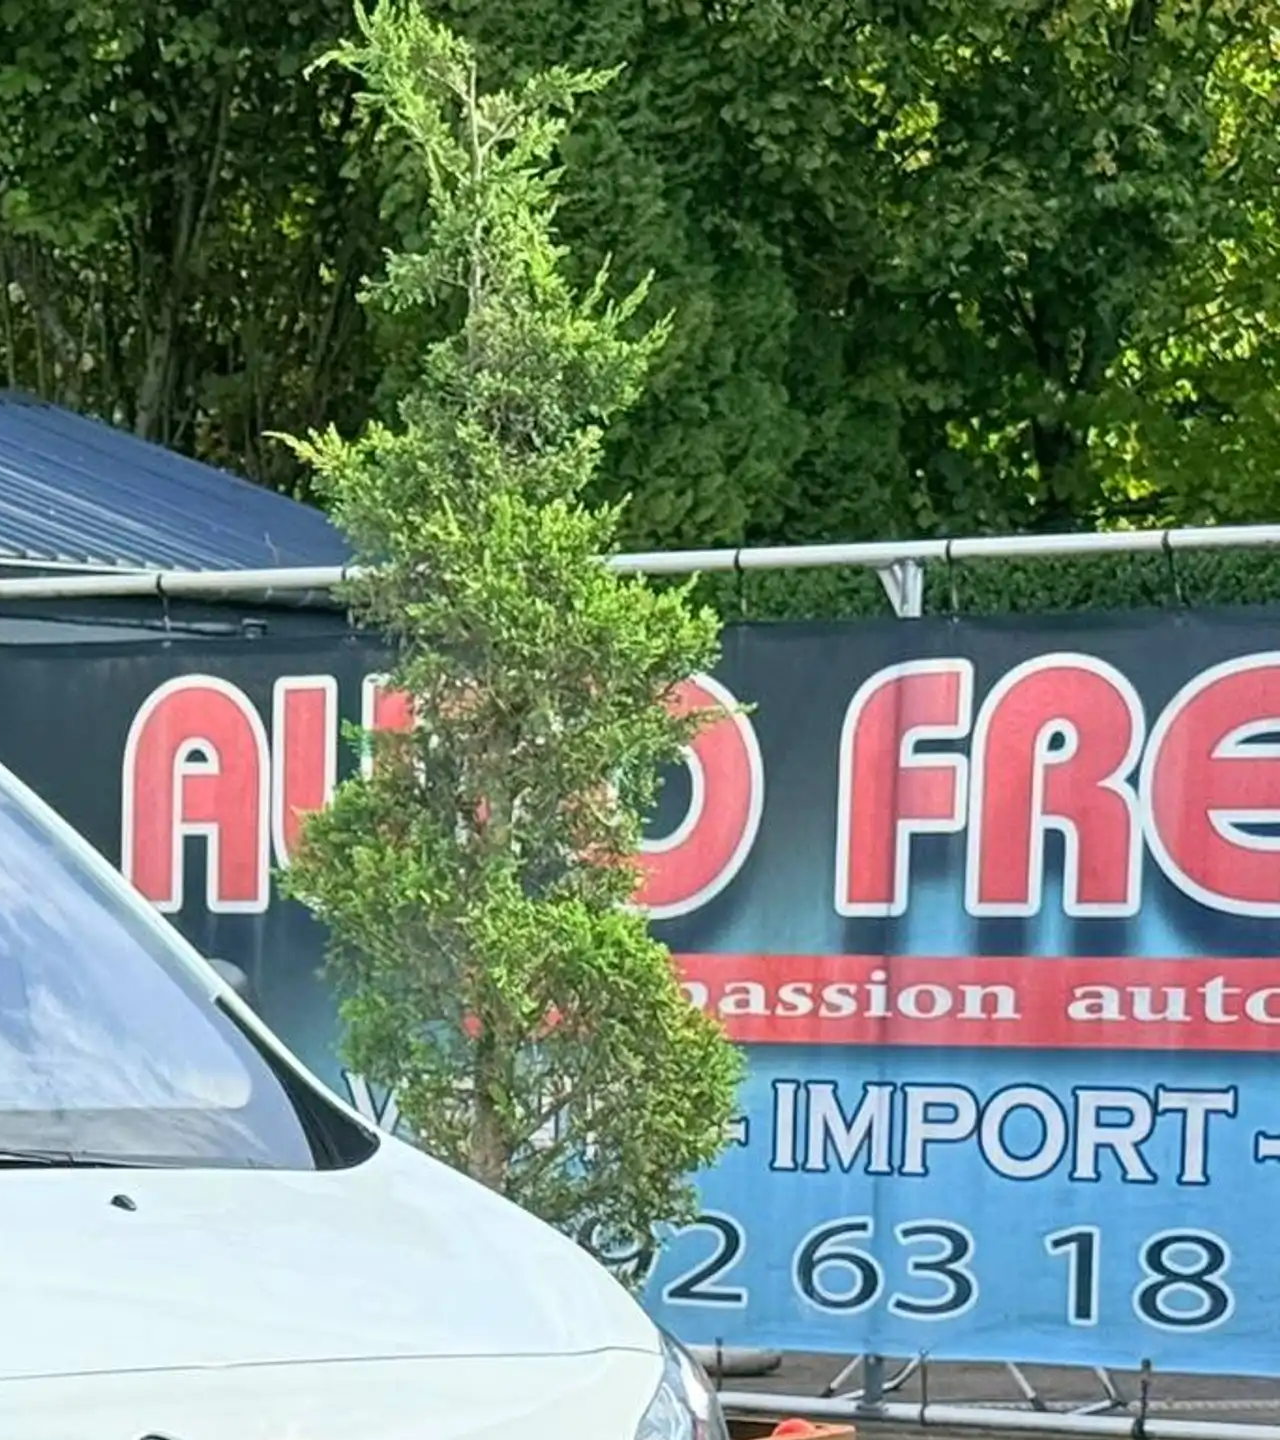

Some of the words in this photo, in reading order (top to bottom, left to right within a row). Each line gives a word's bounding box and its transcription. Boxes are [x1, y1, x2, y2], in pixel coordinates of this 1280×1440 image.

[834, 651, 1280, 919] FRE
[771, 1079, 1238, 1186] IMPORT
[792, 1214, 980, 1323] 63
[1044, 1223, 1236, 1334] 18
